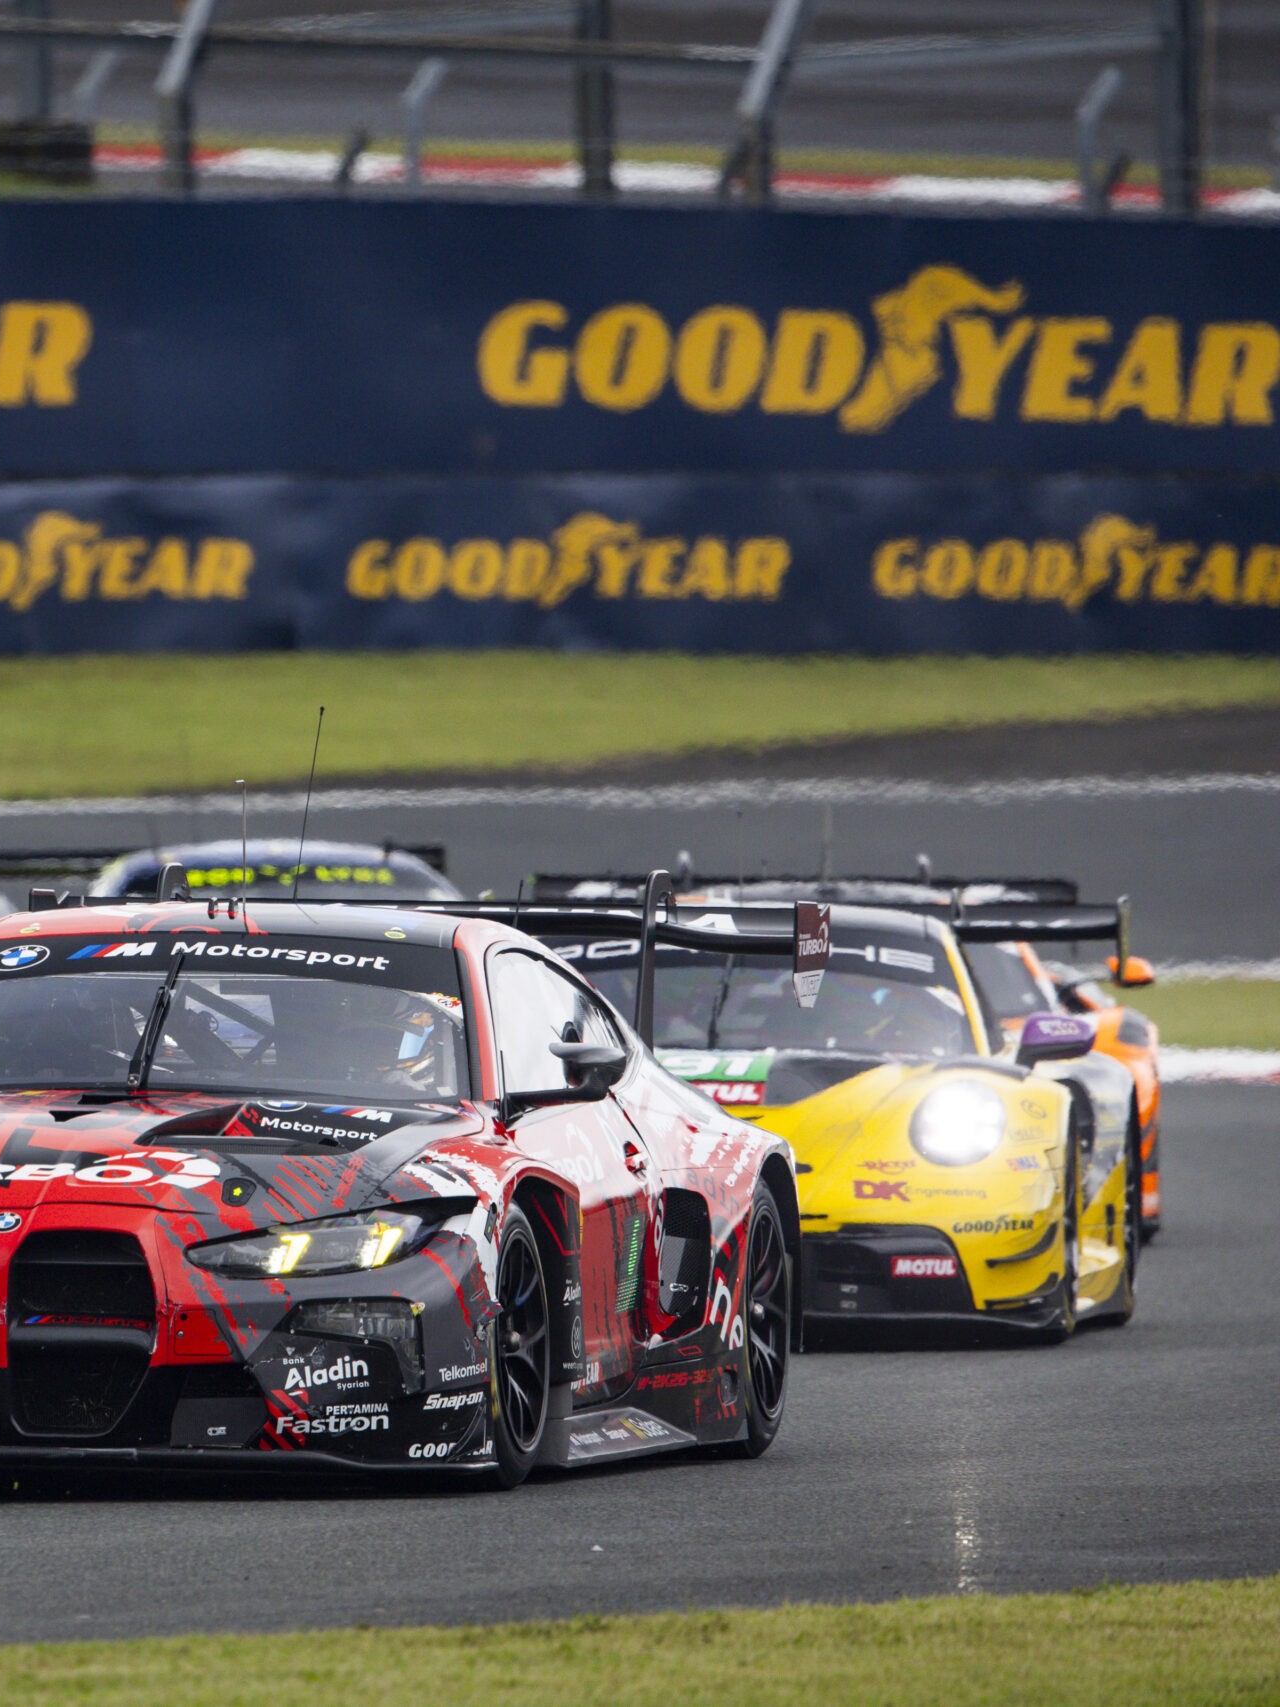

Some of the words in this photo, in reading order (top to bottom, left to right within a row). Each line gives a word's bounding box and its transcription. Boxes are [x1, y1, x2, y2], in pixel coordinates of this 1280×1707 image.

[476, 300, 1280, 426] GOODYEAR
[346, 537, 791, 602] GOODYEAR
[872, 537, 1280, 606] GOODYEAR
[170, 941, 390, 971] Motorsport
[259, 1116, 379, 1142] Motorsport
[853, 1180, 910, 1202] DK
[952, 1215, 1035, 1234] GOODYEAR
[894, 1258, 957, 1276] MOTUL
[282, 1357, 305, 1366] Bank
[284, 1355, 370, 1390] Aladin
[438, 1358, 488, 1382] Telkomsel
[336, 1381, 370, 1392] Syariah
[325, 1401, 389, 1417] PERTAMINA
[422, 1390, 485, 1411] Snap-on
[275, 1413, 390, 1435] Fastron
